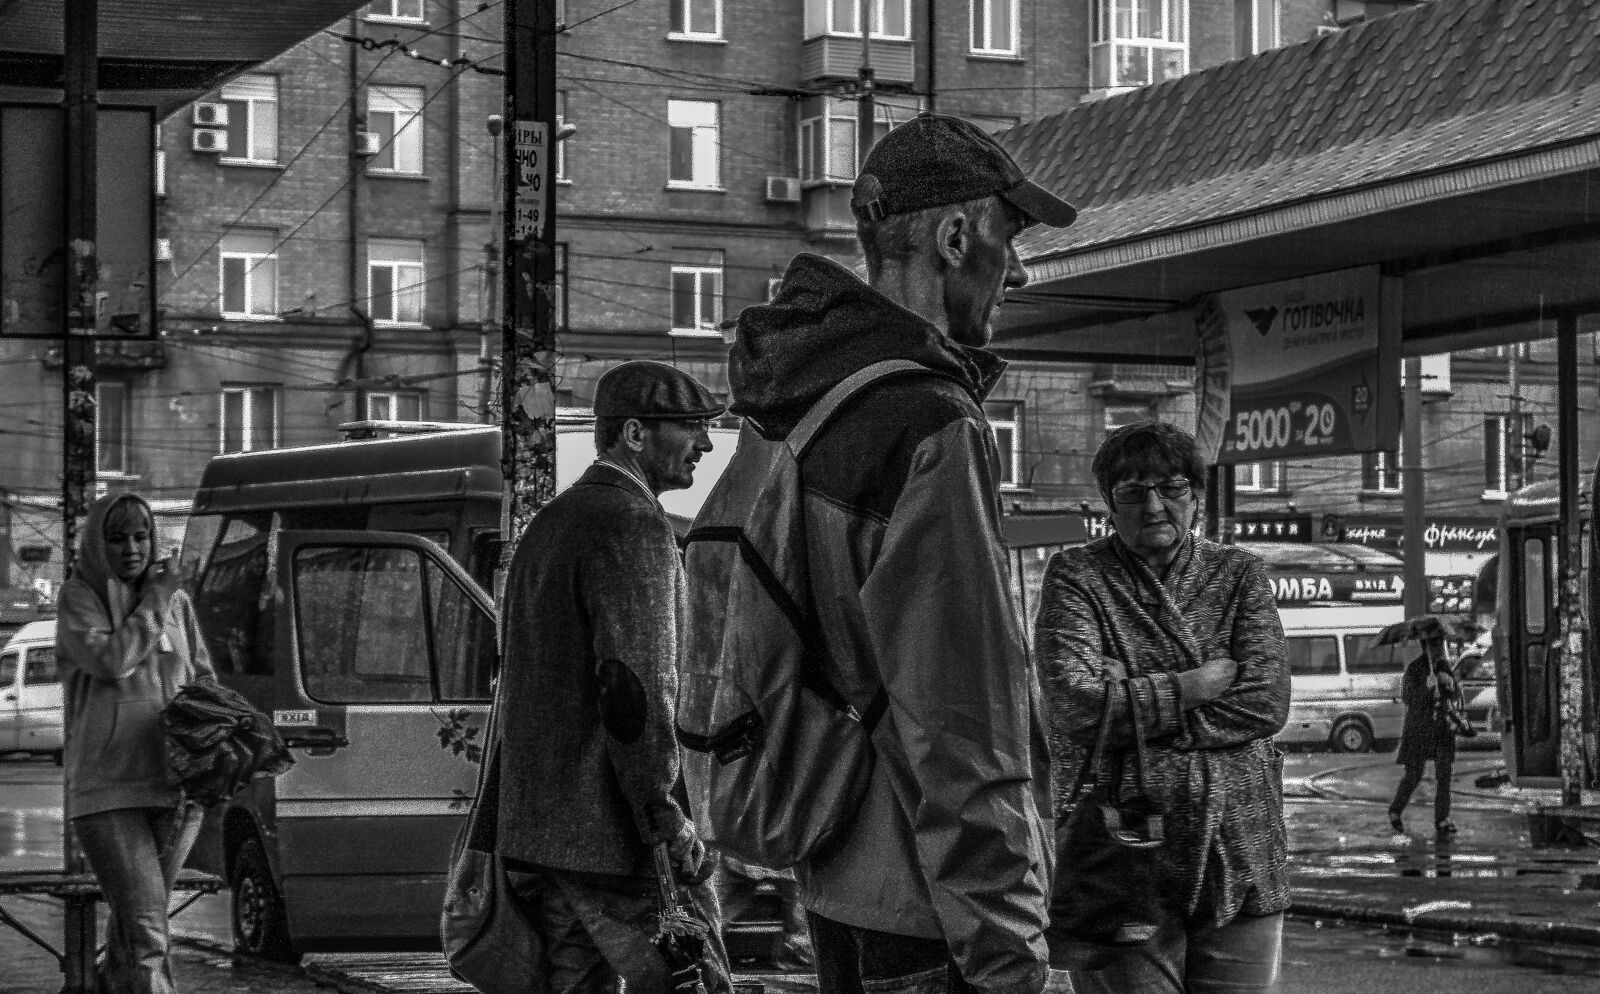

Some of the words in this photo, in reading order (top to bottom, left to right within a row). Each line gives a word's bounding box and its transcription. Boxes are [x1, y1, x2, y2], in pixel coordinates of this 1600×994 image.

[1283, 297, 1365, 332] ГОТІВОЧКА
[1236, 407, 1291, 451] 5000
[1304, 403, 1336, 446] 20
